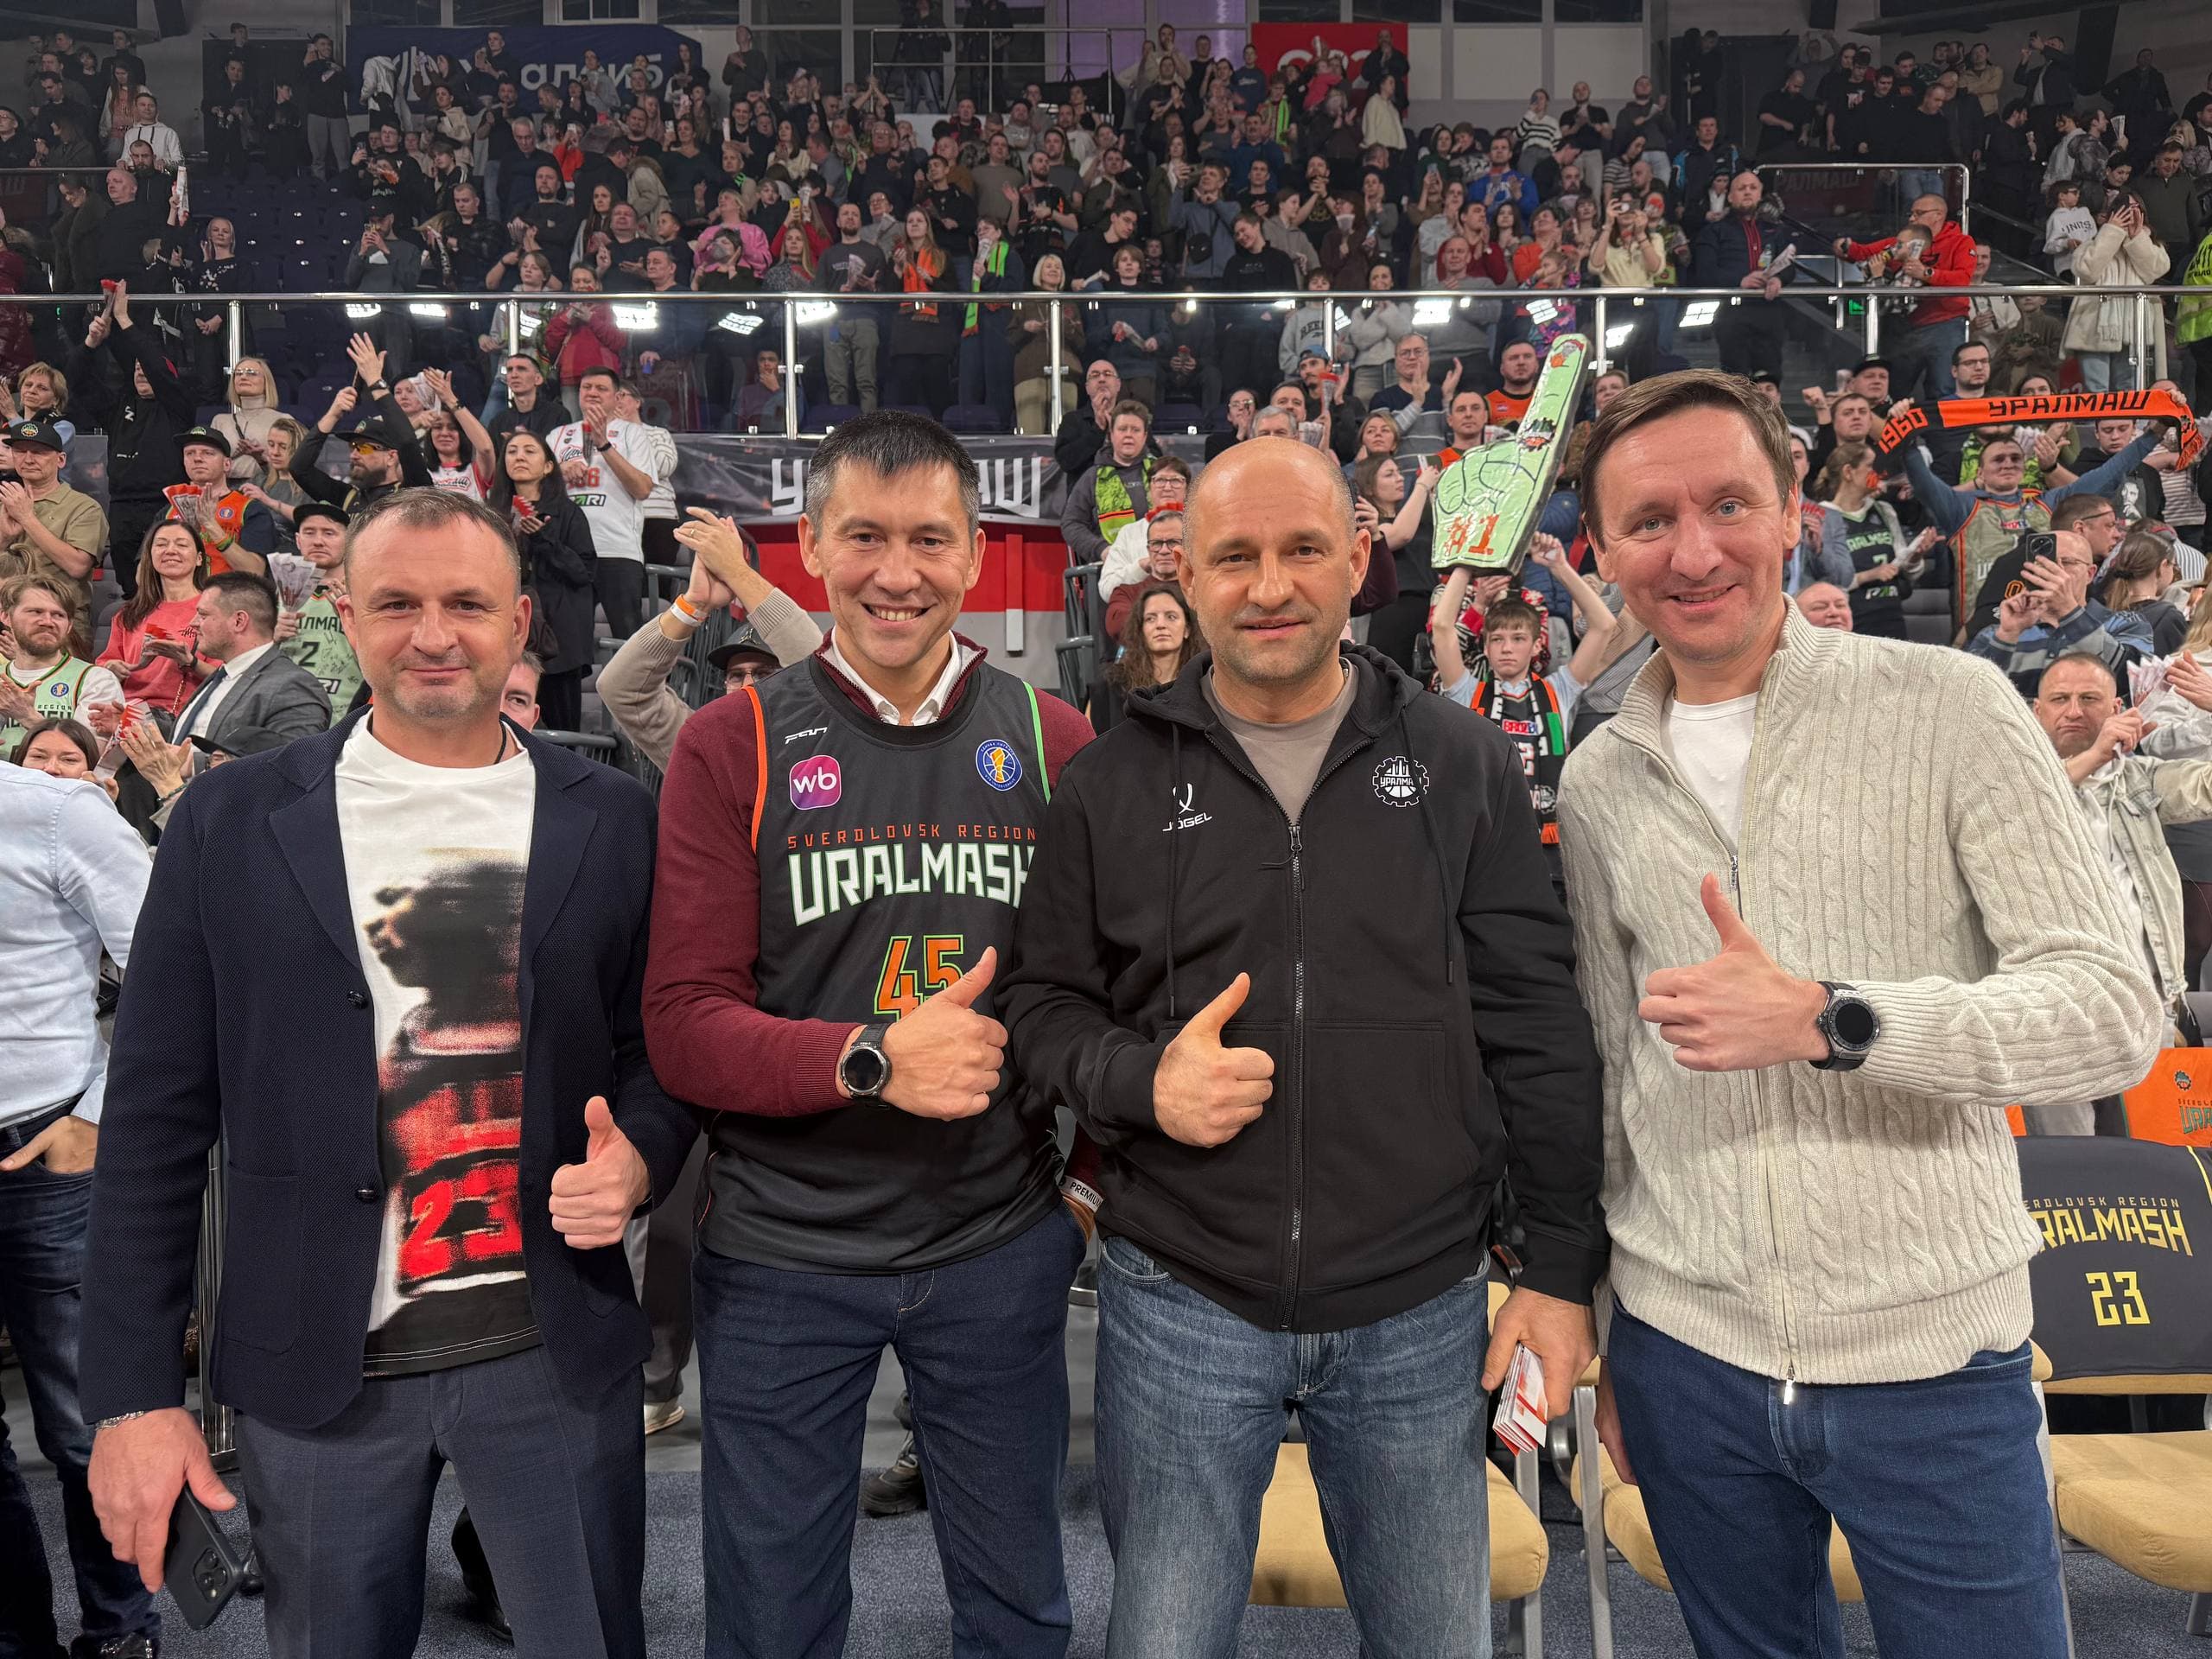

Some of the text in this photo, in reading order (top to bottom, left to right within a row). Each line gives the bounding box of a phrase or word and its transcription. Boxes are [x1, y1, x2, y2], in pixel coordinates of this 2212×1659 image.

[1878, 391, 2152, 454] 1960 УРАЛМАШ
[792, 766, 837, 793] wb
[787, 823, 1036, 849] SVERDLOVSK REGION
[788, 842, 1035, 926] URALMASH
[874, 934, 964, 1023] 45
[2023, 1196, 2180, 1210] ERDLOVSK REGION
[2029, 1208, 2194, 1257] RALMASH
[2085, 1271, 2151, 1326] 23
